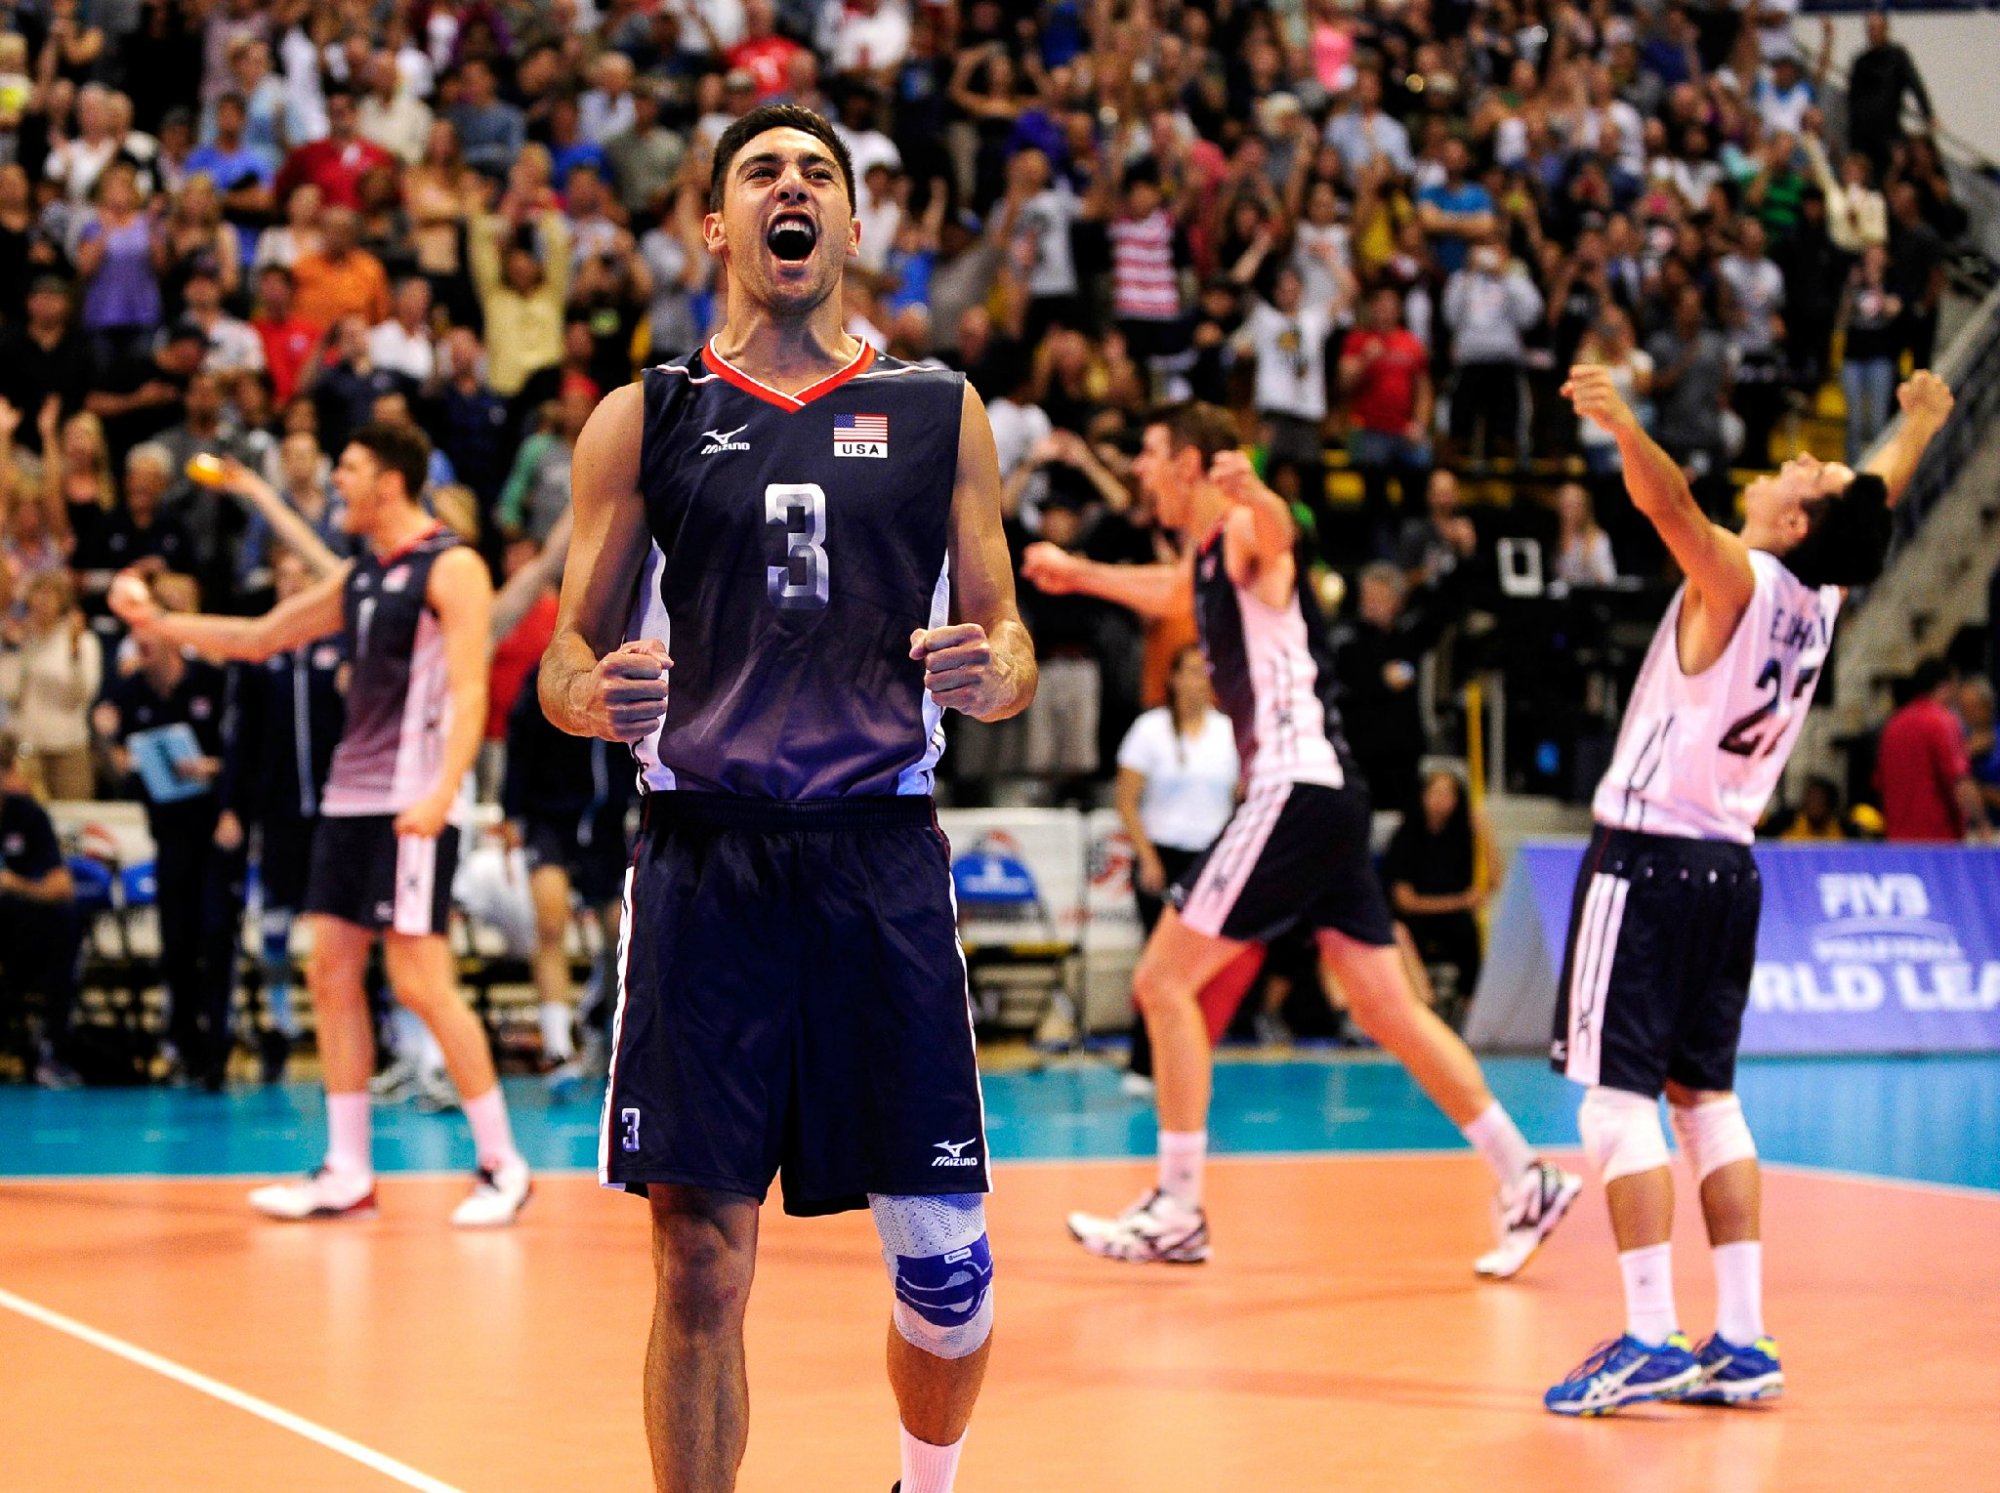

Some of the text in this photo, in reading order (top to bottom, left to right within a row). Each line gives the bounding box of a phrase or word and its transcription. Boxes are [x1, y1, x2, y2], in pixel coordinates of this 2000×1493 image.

[842, 443, 880, 455] USA
[765, 483, 830, 610] 3
[1818, 873, 1931, 918] FIVB
[621, 1107, 641, 1152] 3
[931, 1156, 978, 1167] MIZUNO
